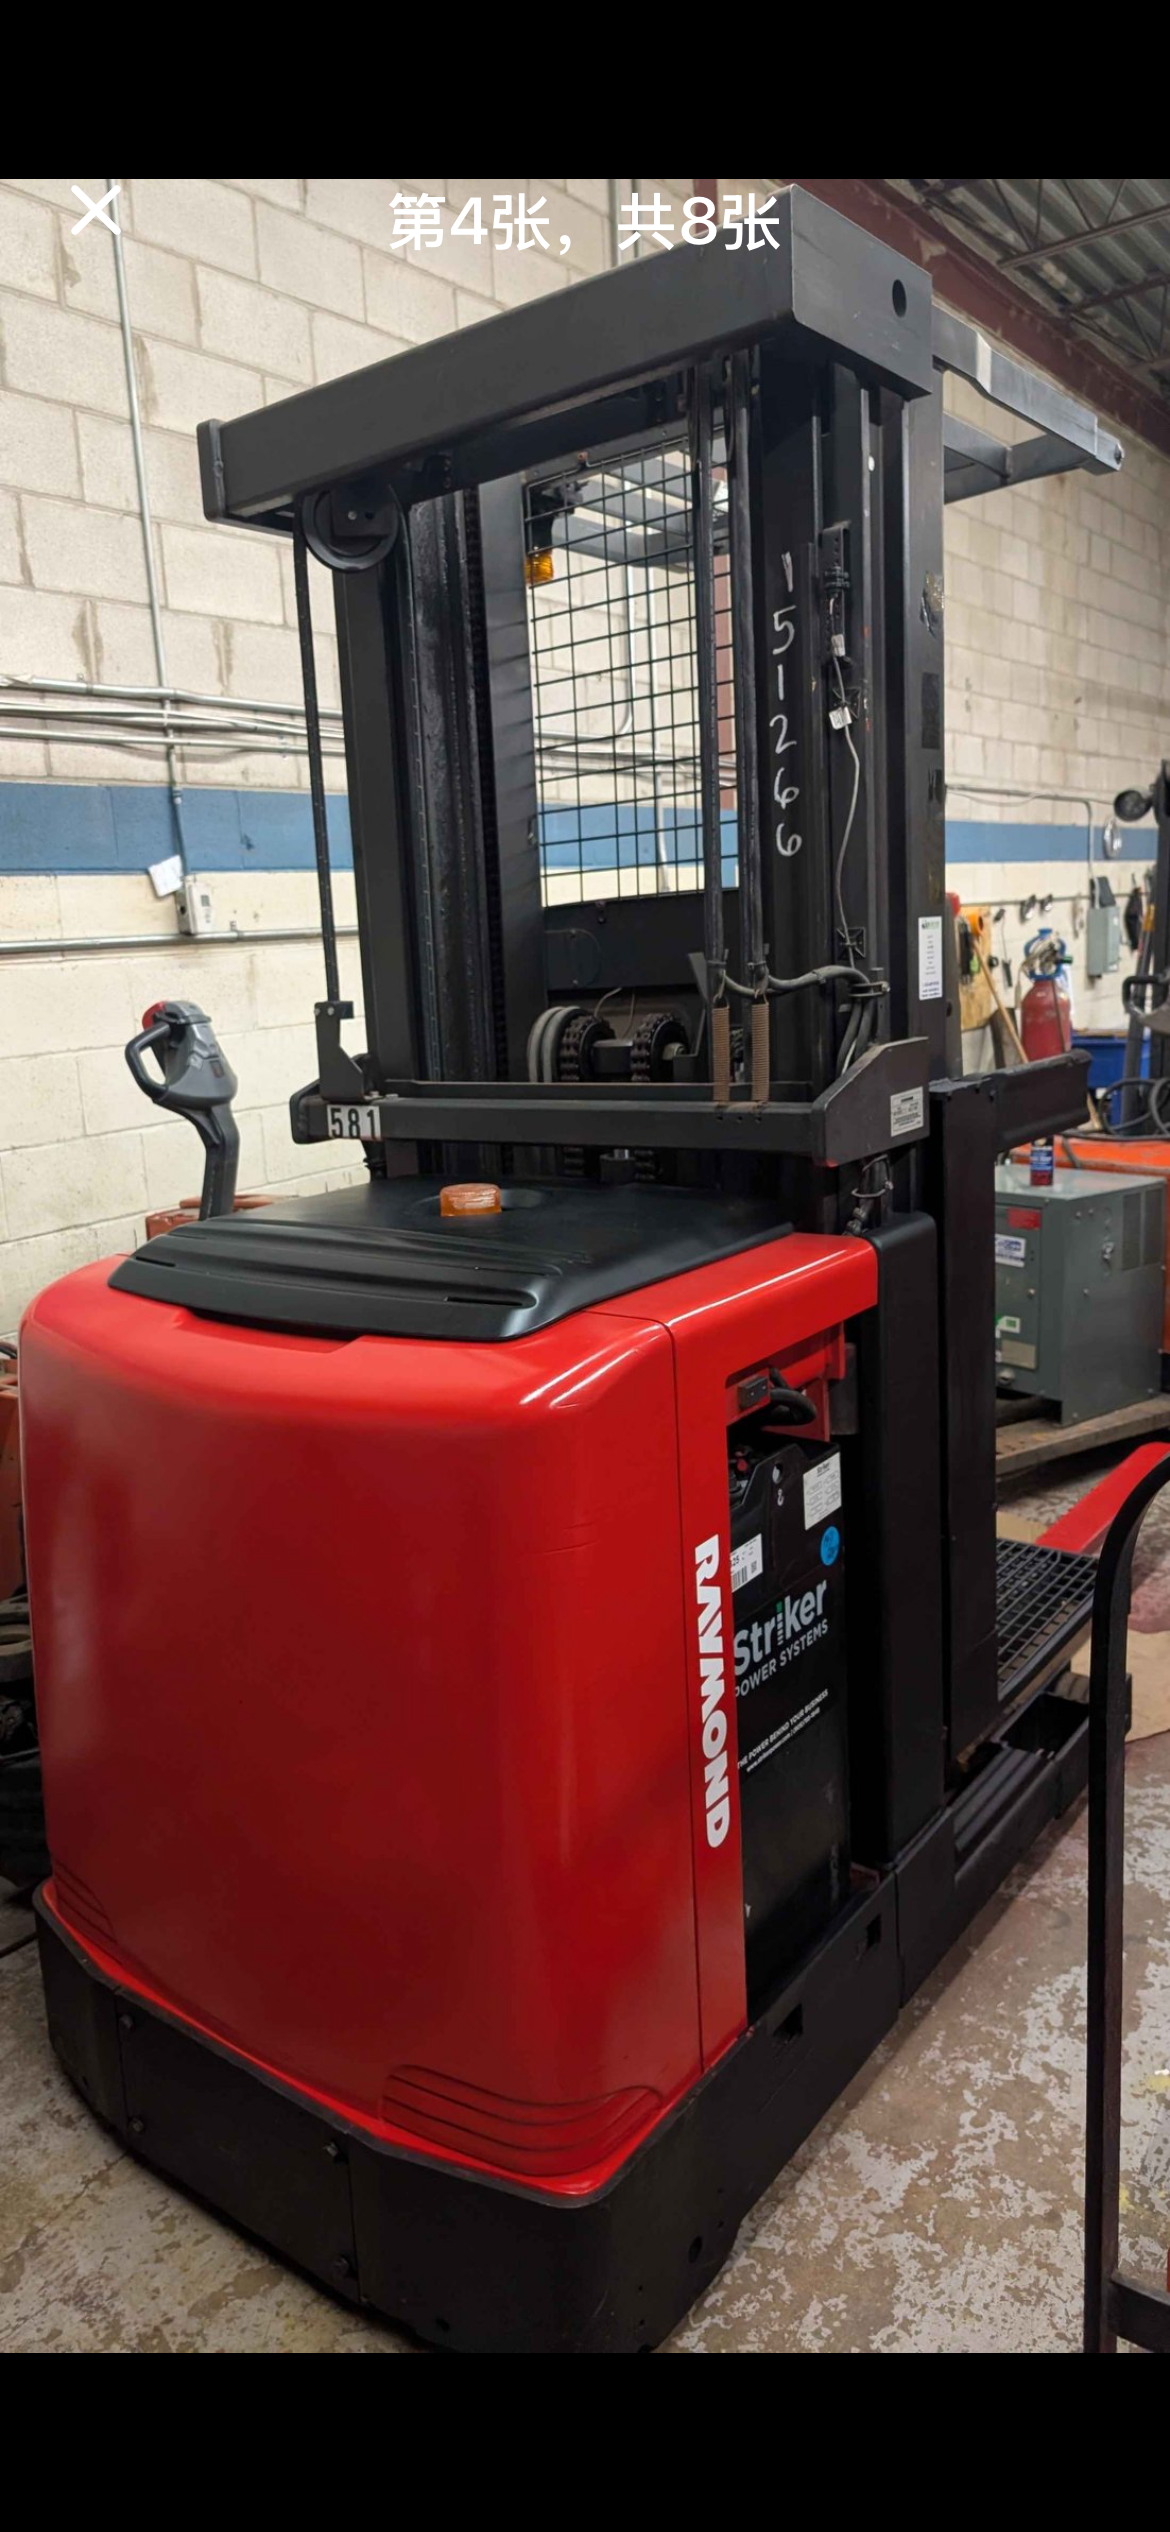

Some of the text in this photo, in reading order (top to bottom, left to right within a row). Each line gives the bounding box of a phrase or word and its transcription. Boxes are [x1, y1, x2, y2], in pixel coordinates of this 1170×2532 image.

[769, 551, 802, 857] 151266
[330, 1107, 377, 1140] 581
[733, 1579, 827, 1677] Striker
[780, 1618, 828, 1667] SYSTEMS
[694, 1533, 731, 1849] RAYMOND
[749, 1739, 769, 1760] POWER
[770, 1721, 790, 1743] BEHIND
[790, 1709, 804, 1726] YOUR
